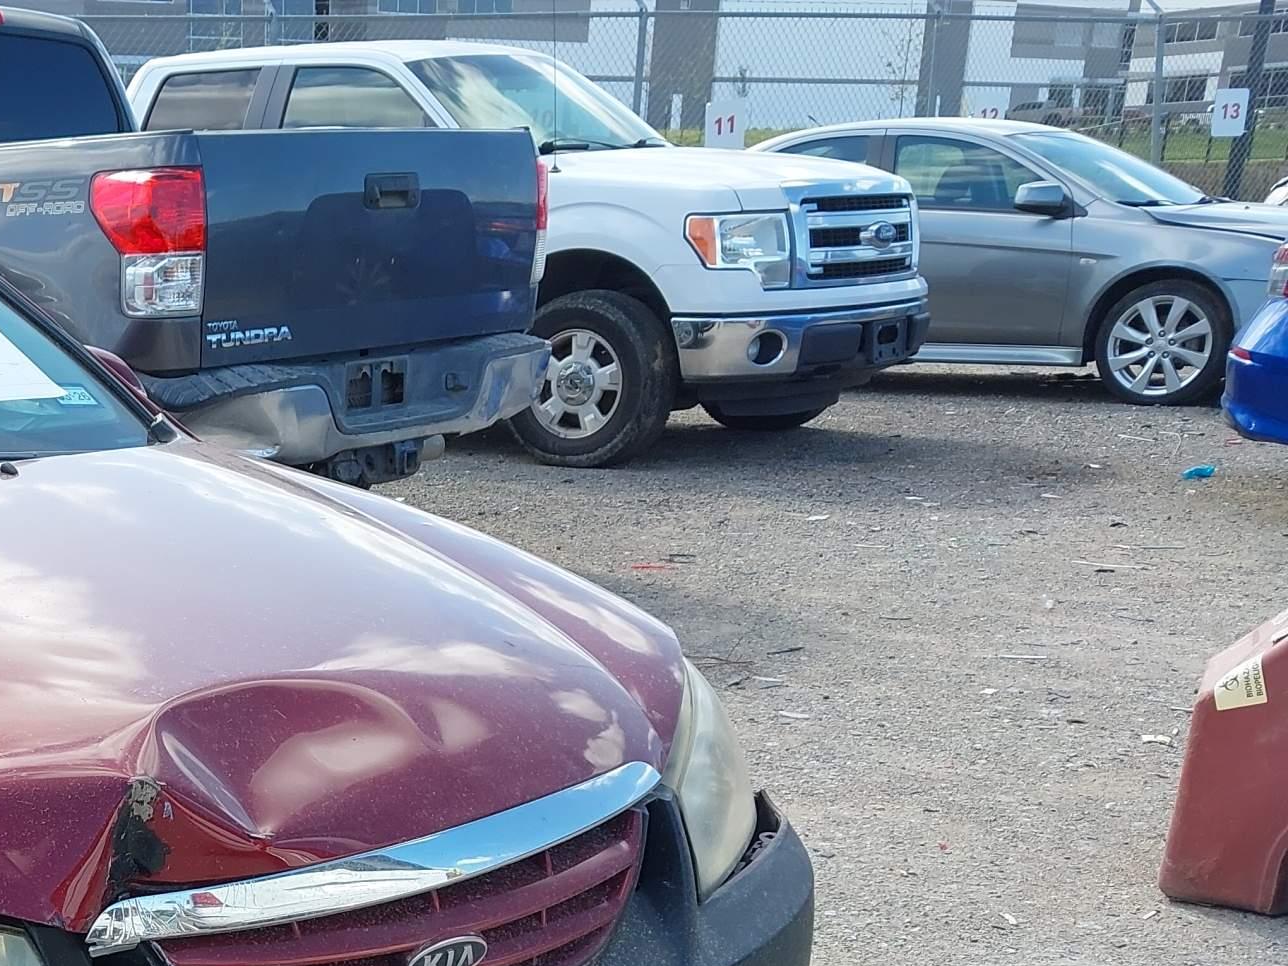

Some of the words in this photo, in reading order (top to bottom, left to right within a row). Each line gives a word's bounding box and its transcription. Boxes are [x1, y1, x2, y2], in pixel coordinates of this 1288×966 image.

[1221, 103, 1241, 120] 13
[714, 114, 735, 136] 11
[207, 319, 238, 331] TOYOTA
[206, 326, 292, 348] TUNDRA
